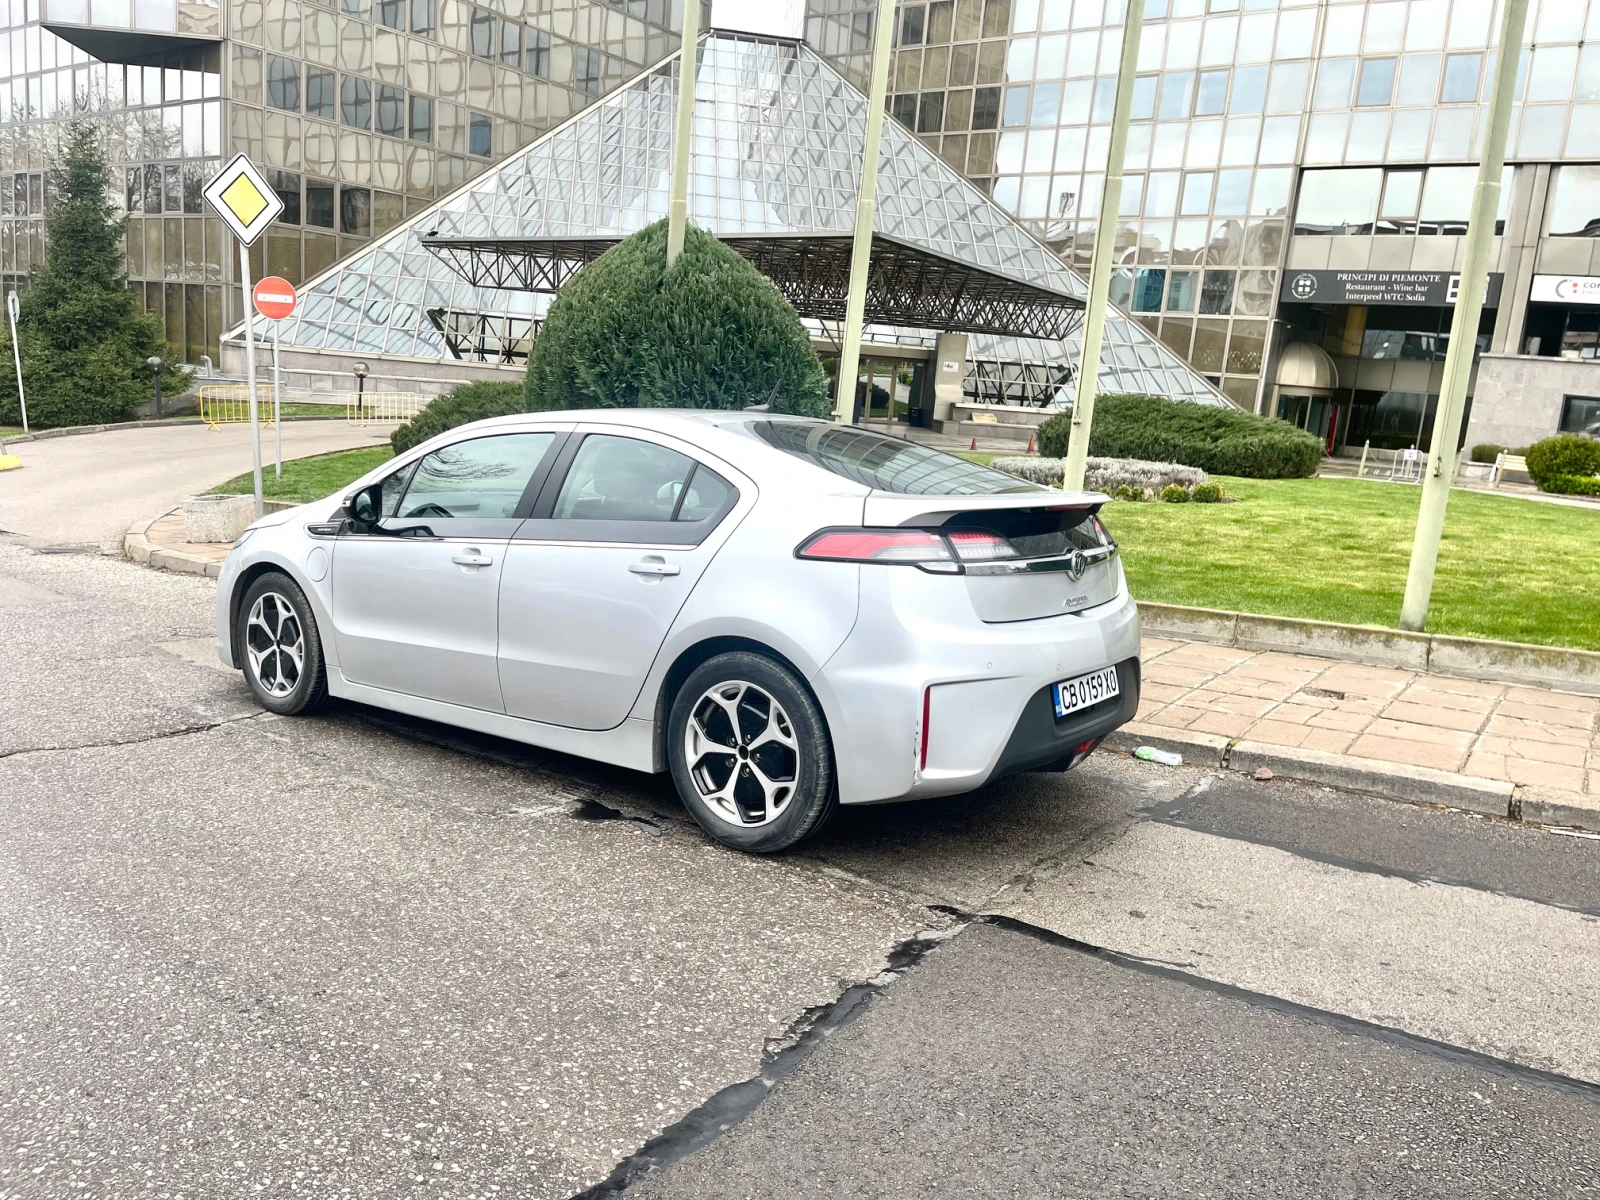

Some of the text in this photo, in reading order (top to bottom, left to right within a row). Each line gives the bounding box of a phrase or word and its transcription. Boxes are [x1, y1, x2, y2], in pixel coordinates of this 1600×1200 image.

[1337, 273, 1442, 283] PRINCIPI DI PIEMONTE
[1345, 282, 1386, 291] Restaurant
[1393, 283, 1414, 292] Wine
[1414, 283, 1430, 292] bar
[1345, 292, 1426, 302] Interpred WTC Sofia
[1061, 683, 1078, 710] CB
[1079, 674, 1104, 704] 0159
